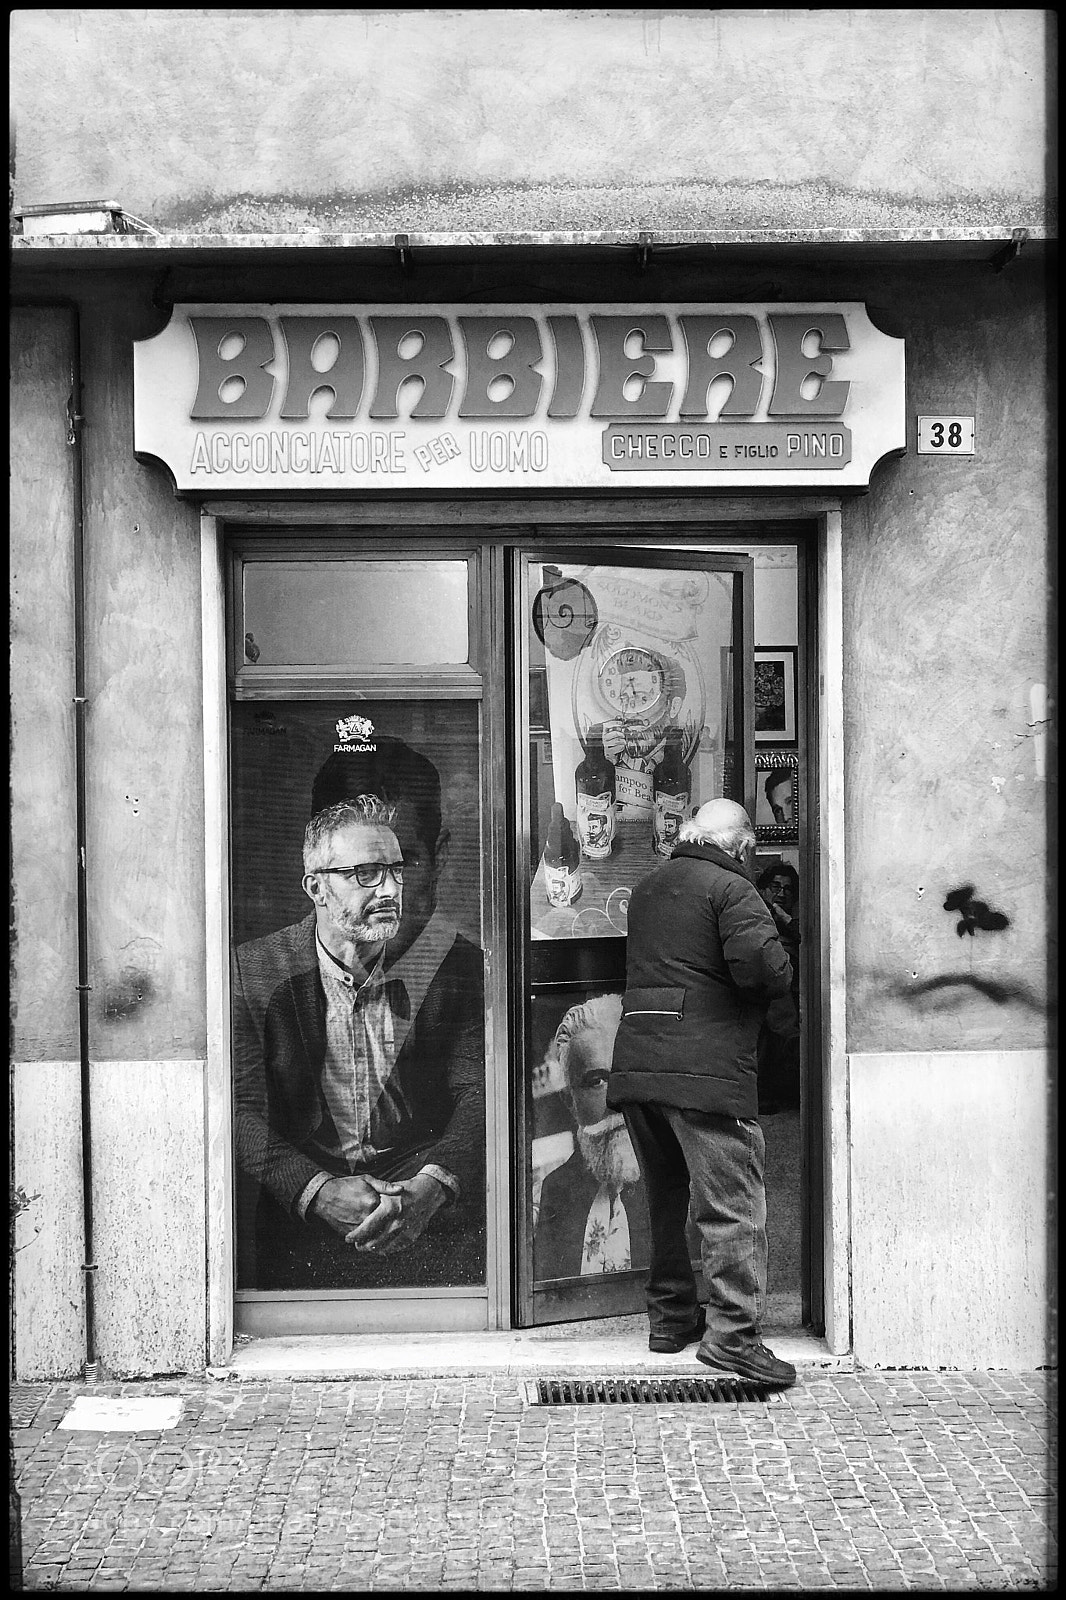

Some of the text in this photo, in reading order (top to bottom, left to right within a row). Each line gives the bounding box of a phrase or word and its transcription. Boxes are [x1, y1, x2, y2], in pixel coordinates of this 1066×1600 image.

[188, 313, 851, 419] BARBIERE
[611, 433, 844, 459] CHECCO E FIGLIO PINO
[930, 422, 963, 449] 38
[190, 430, 549, 474] ACCONCIATORE PER UOMO
[333, 744, 377, 752] FARMAGAN
[615, 774, 648, 790] ampoo
[619, 784, 631, 795] for
[635, 789, 651, 802] Bea
